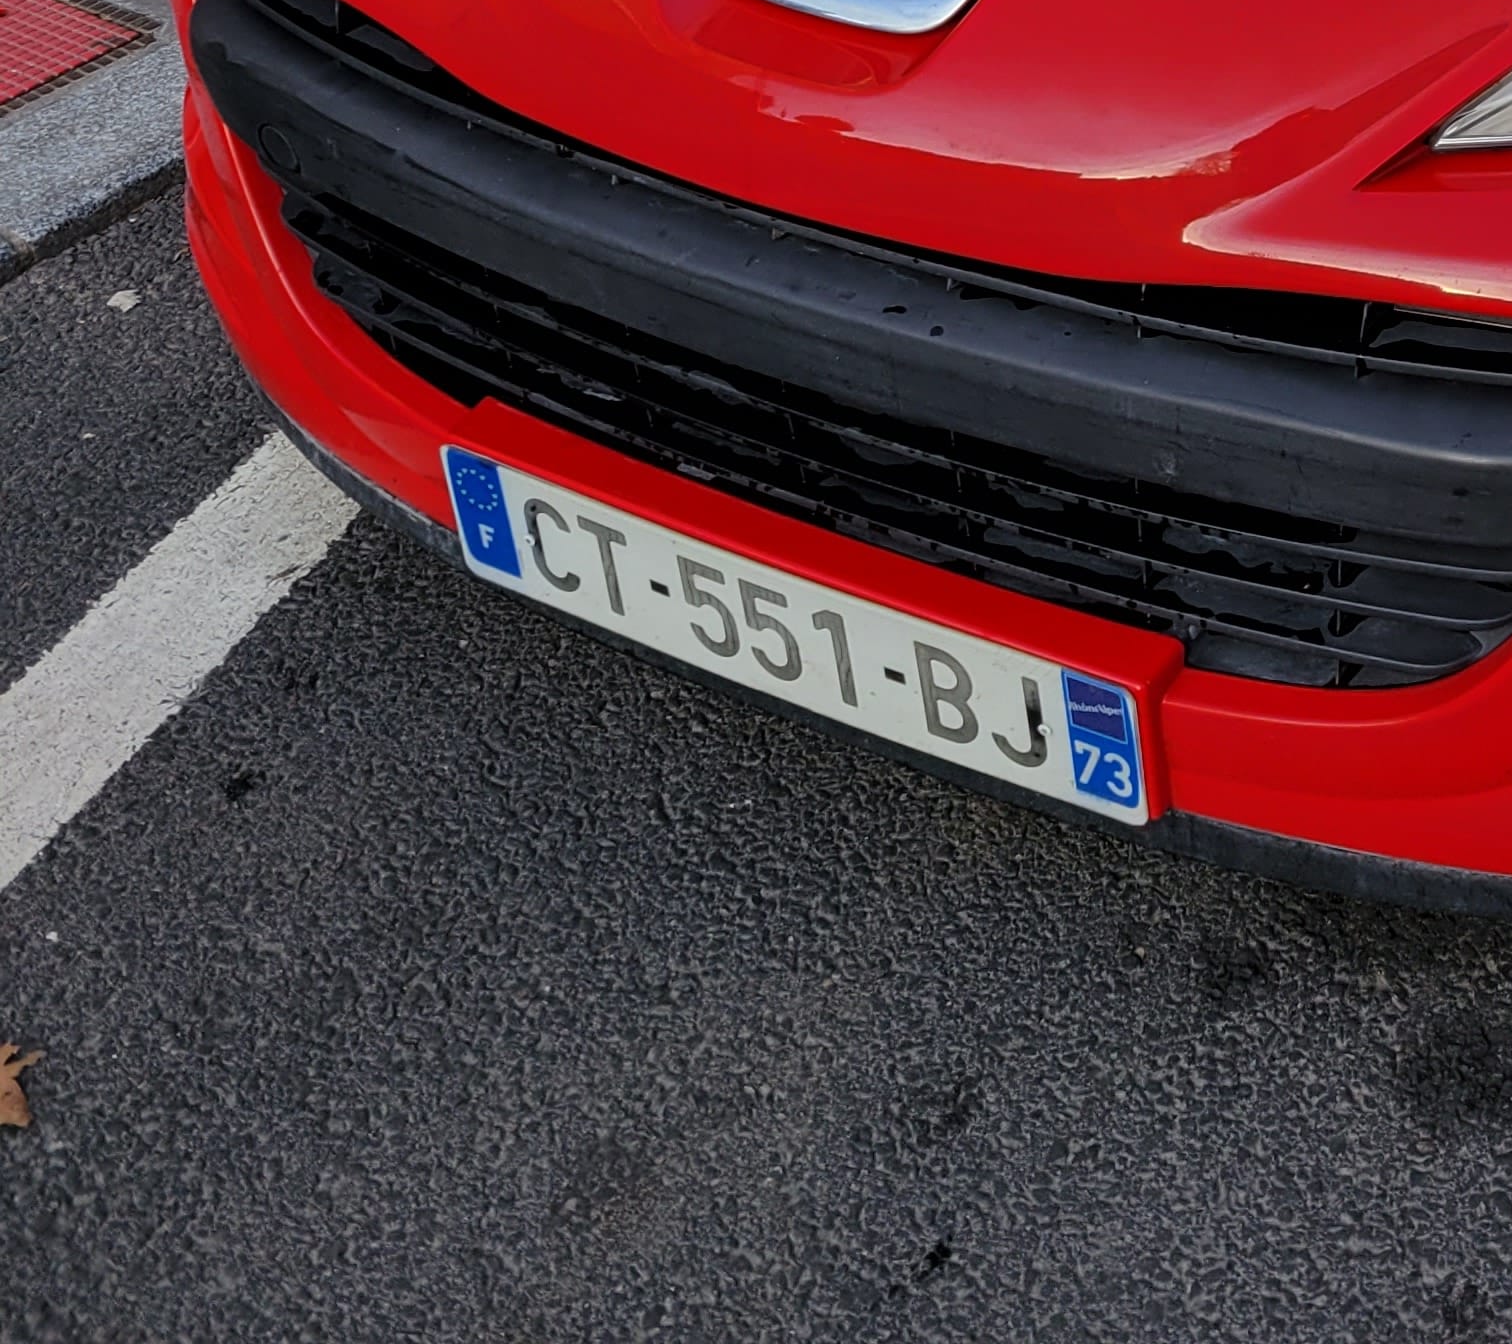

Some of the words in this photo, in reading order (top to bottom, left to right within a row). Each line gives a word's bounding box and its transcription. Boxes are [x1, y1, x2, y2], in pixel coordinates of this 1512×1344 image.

[478, 522, 496, 549] F
[523, 498, 1048, 768] CT-551-BJ
[1074, 739, 1133, 799] 73
